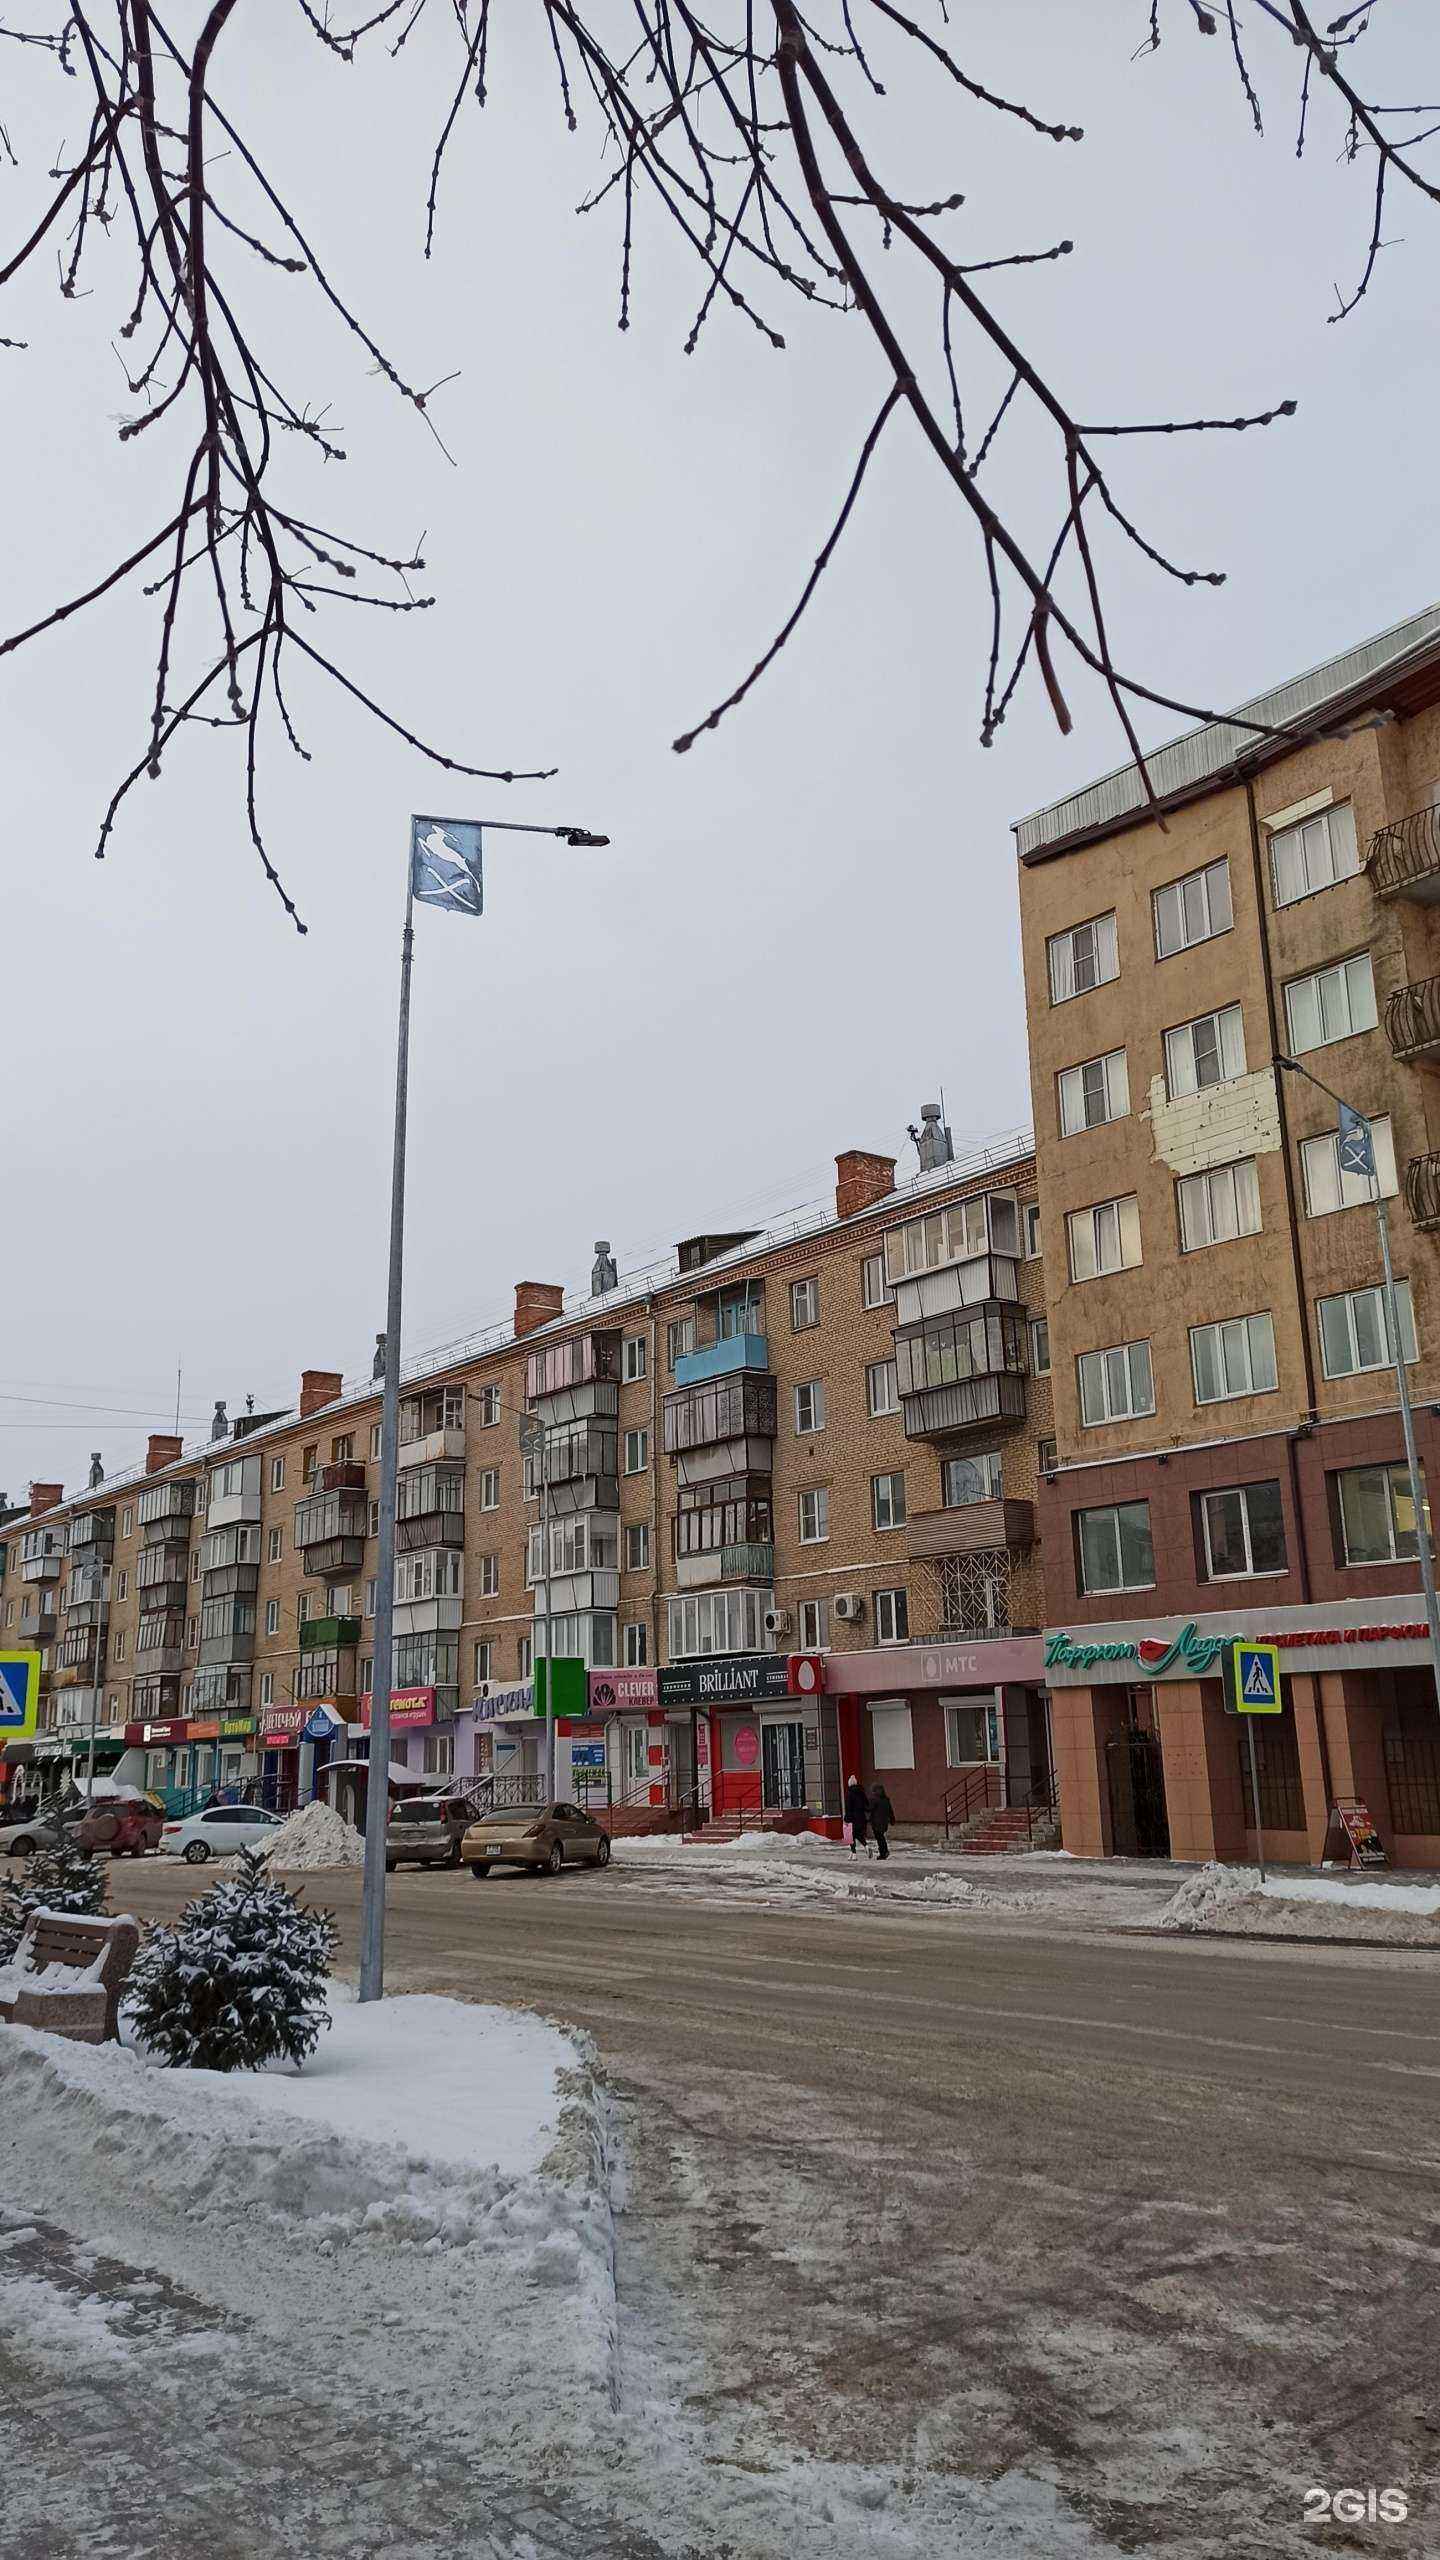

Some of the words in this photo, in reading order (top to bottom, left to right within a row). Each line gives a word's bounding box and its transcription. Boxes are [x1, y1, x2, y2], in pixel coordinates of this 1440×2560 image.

[1344, 1628, 1357, 1643] И
[946, 1656, 977, 1672] МТС
[617, 1681, 654, 1697] CLEVER
